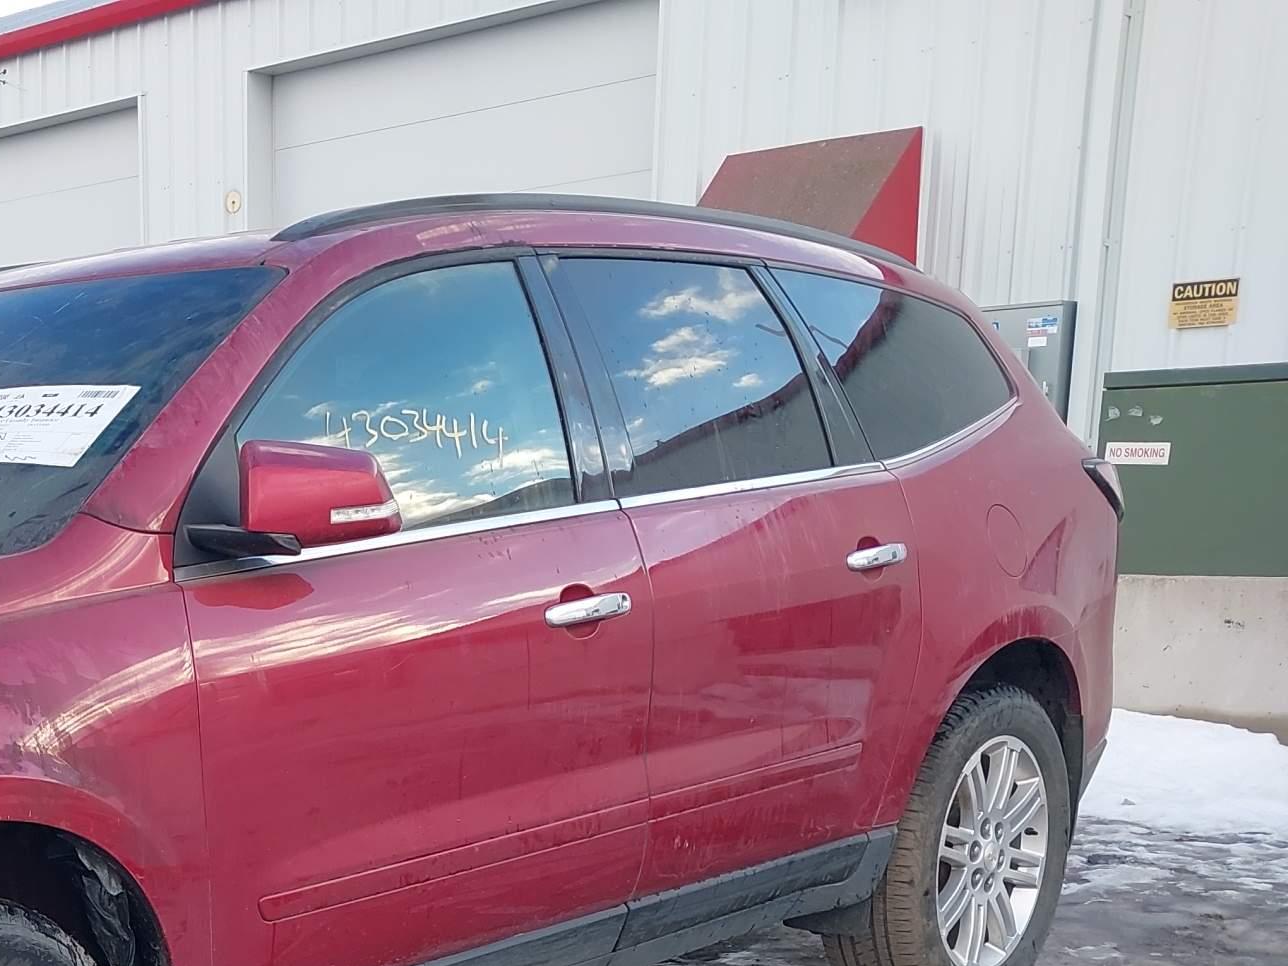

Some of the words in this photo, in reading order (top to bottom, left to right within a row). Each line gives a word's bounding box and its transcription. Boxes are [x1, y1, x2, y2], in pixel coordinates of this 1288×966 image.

[1174, 281, 1238, 299] CAUTION
[325, 408, 509, 467] 43034414
[1109, 447, 1123, 458] NO
[1124, 447, 1165, 458] SMOKING
